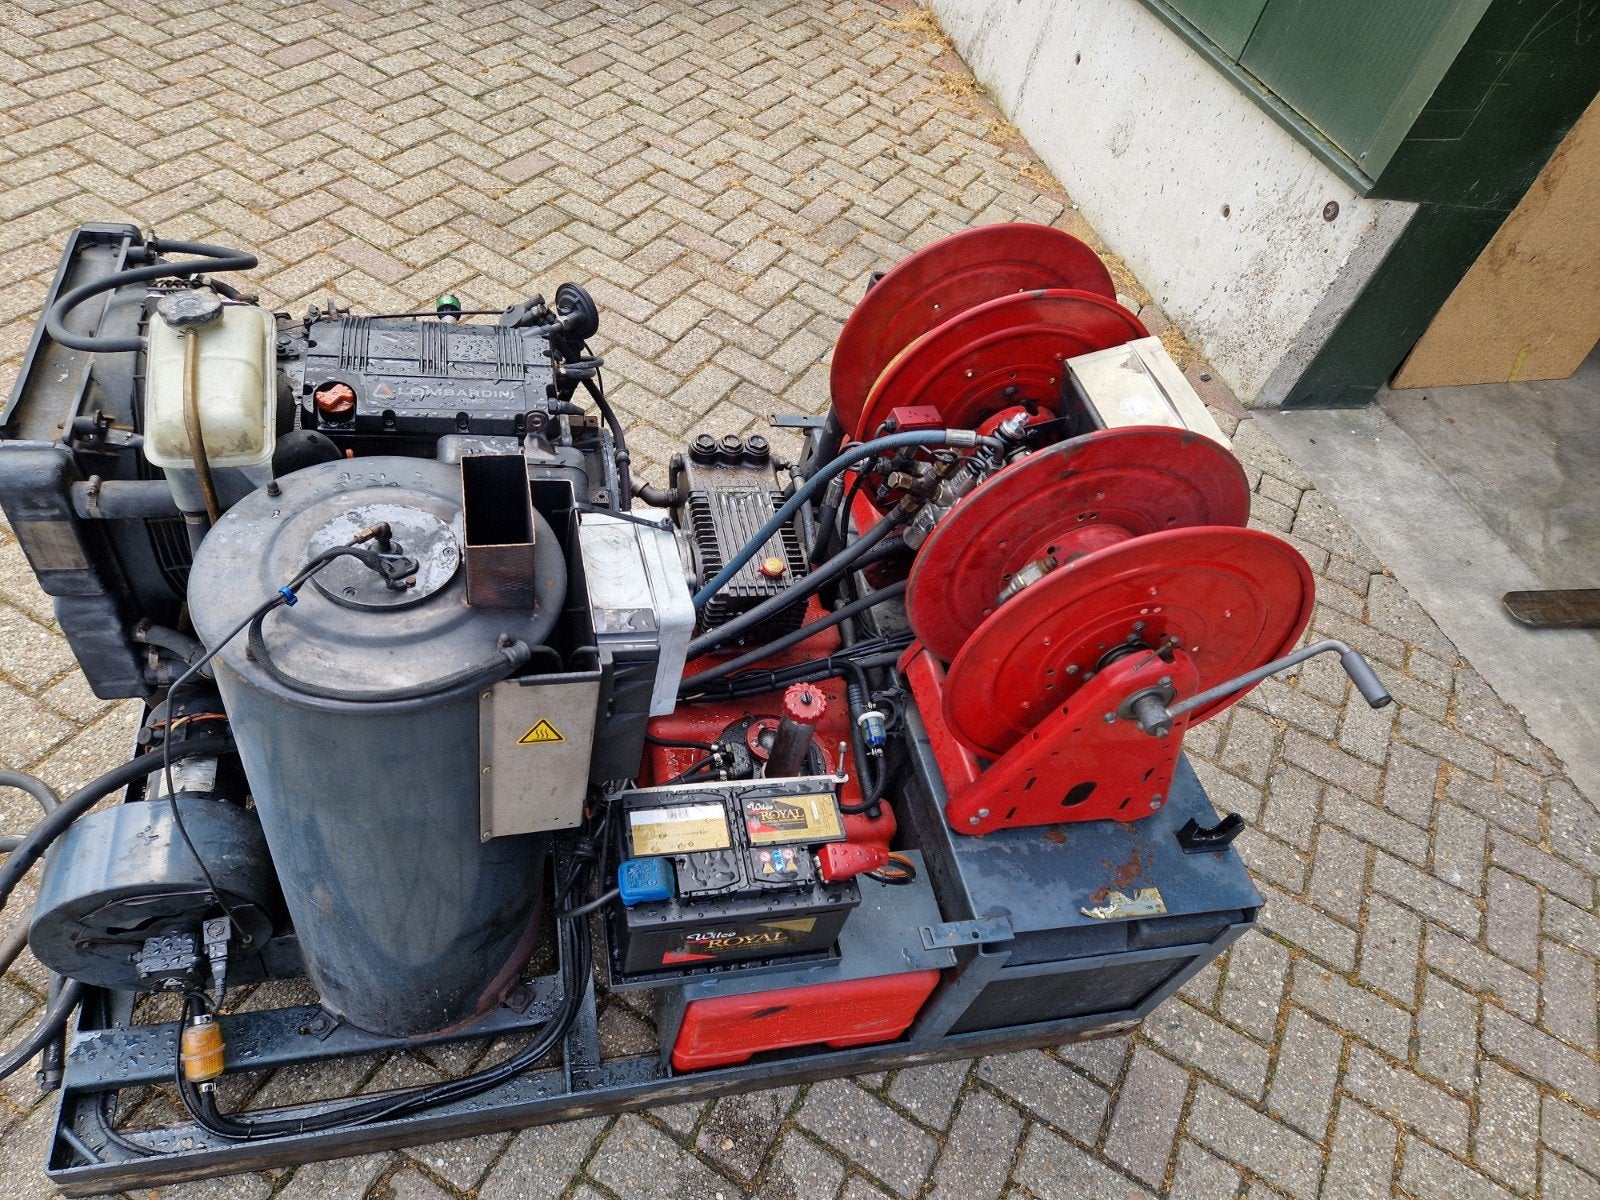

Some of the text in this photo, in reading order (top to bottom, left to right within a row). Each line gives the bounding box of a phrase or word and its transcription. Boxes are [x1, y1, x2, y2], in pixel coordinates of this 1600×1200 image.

[398, 386, 515, 398] LOMBARDINI
[747, 802, 774, 811] Wilco
[760, 808, 805, 821] ROYAL
[686, 931, 737, 941] Wilco
[706, 931, 789, 949] ROYAL
